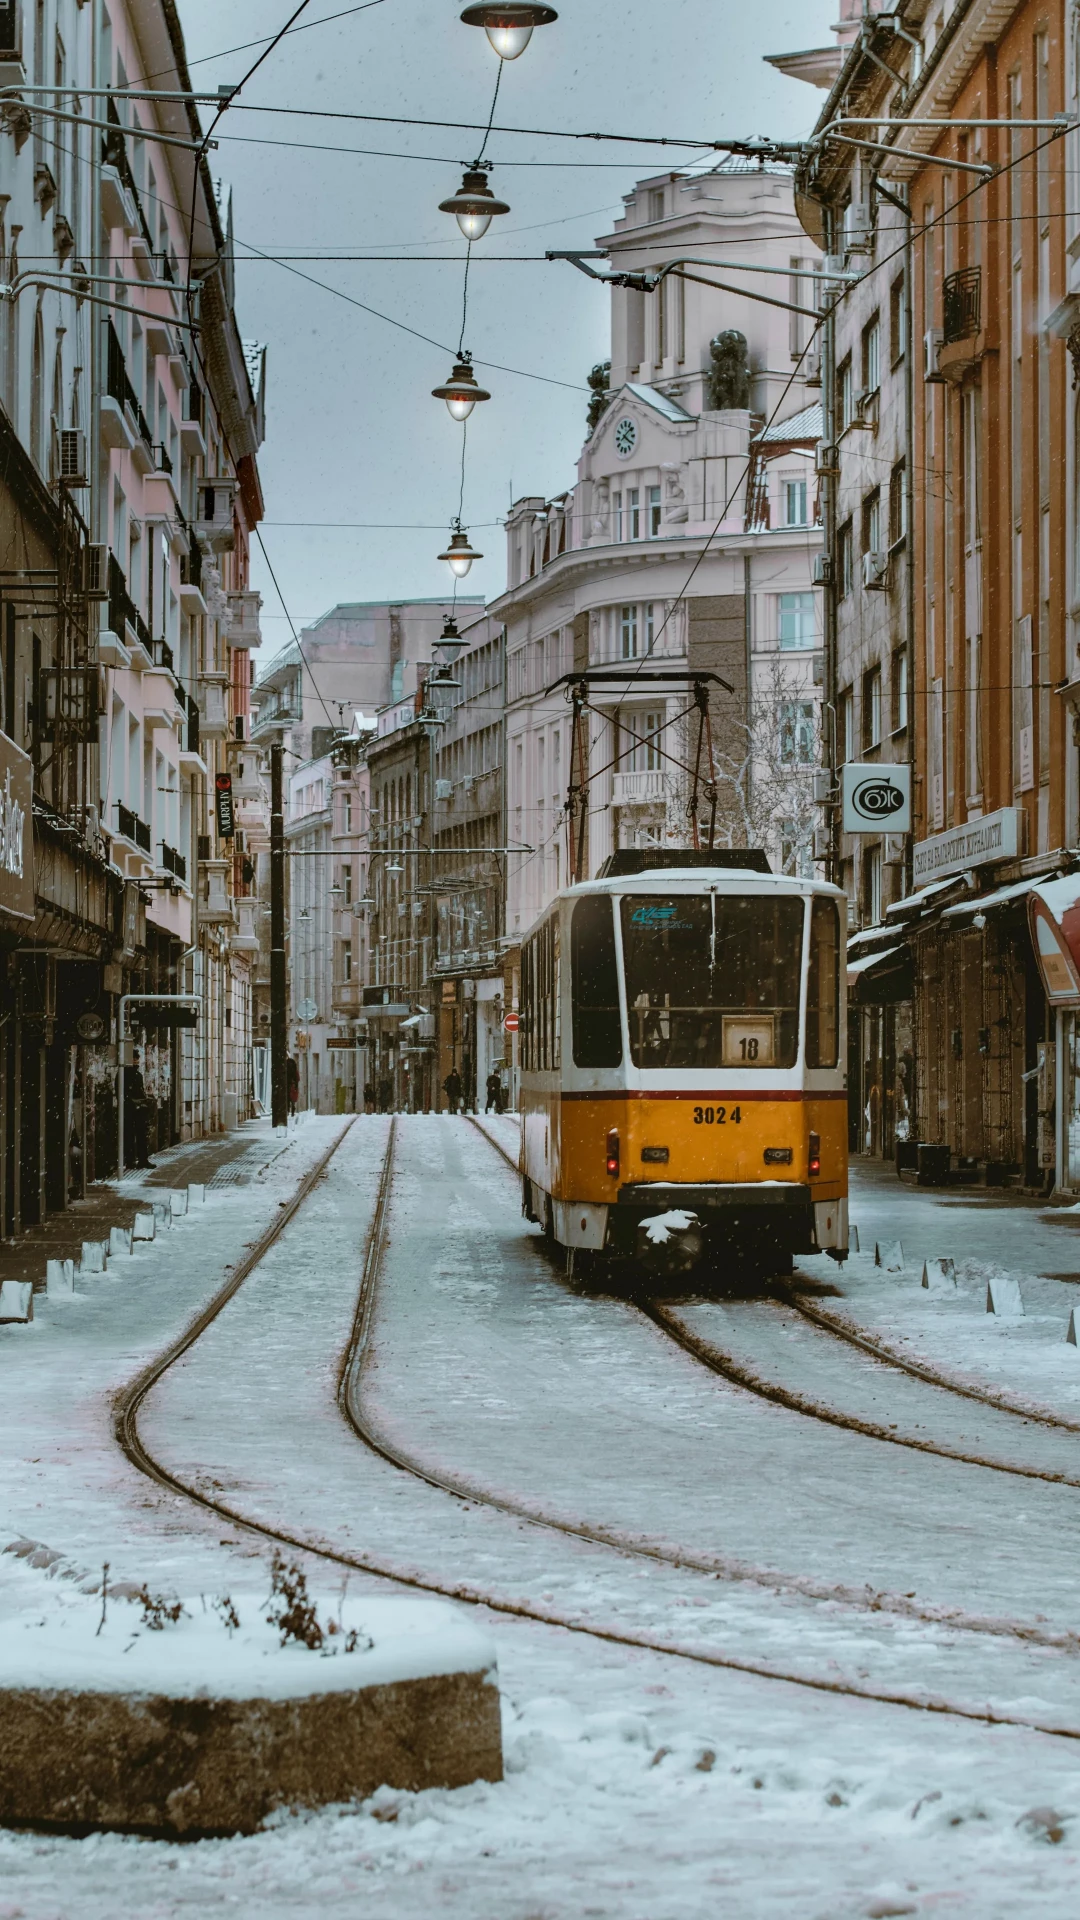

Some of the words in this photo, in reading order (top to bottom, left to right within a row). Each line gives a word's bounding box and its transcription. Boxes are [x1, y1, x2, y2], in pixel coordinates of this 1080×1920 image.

[220, 791, 231, 831] MURPHY
[739, 1038, 759, 1060] 18
[693, 1106, 742, 1125] 3024
